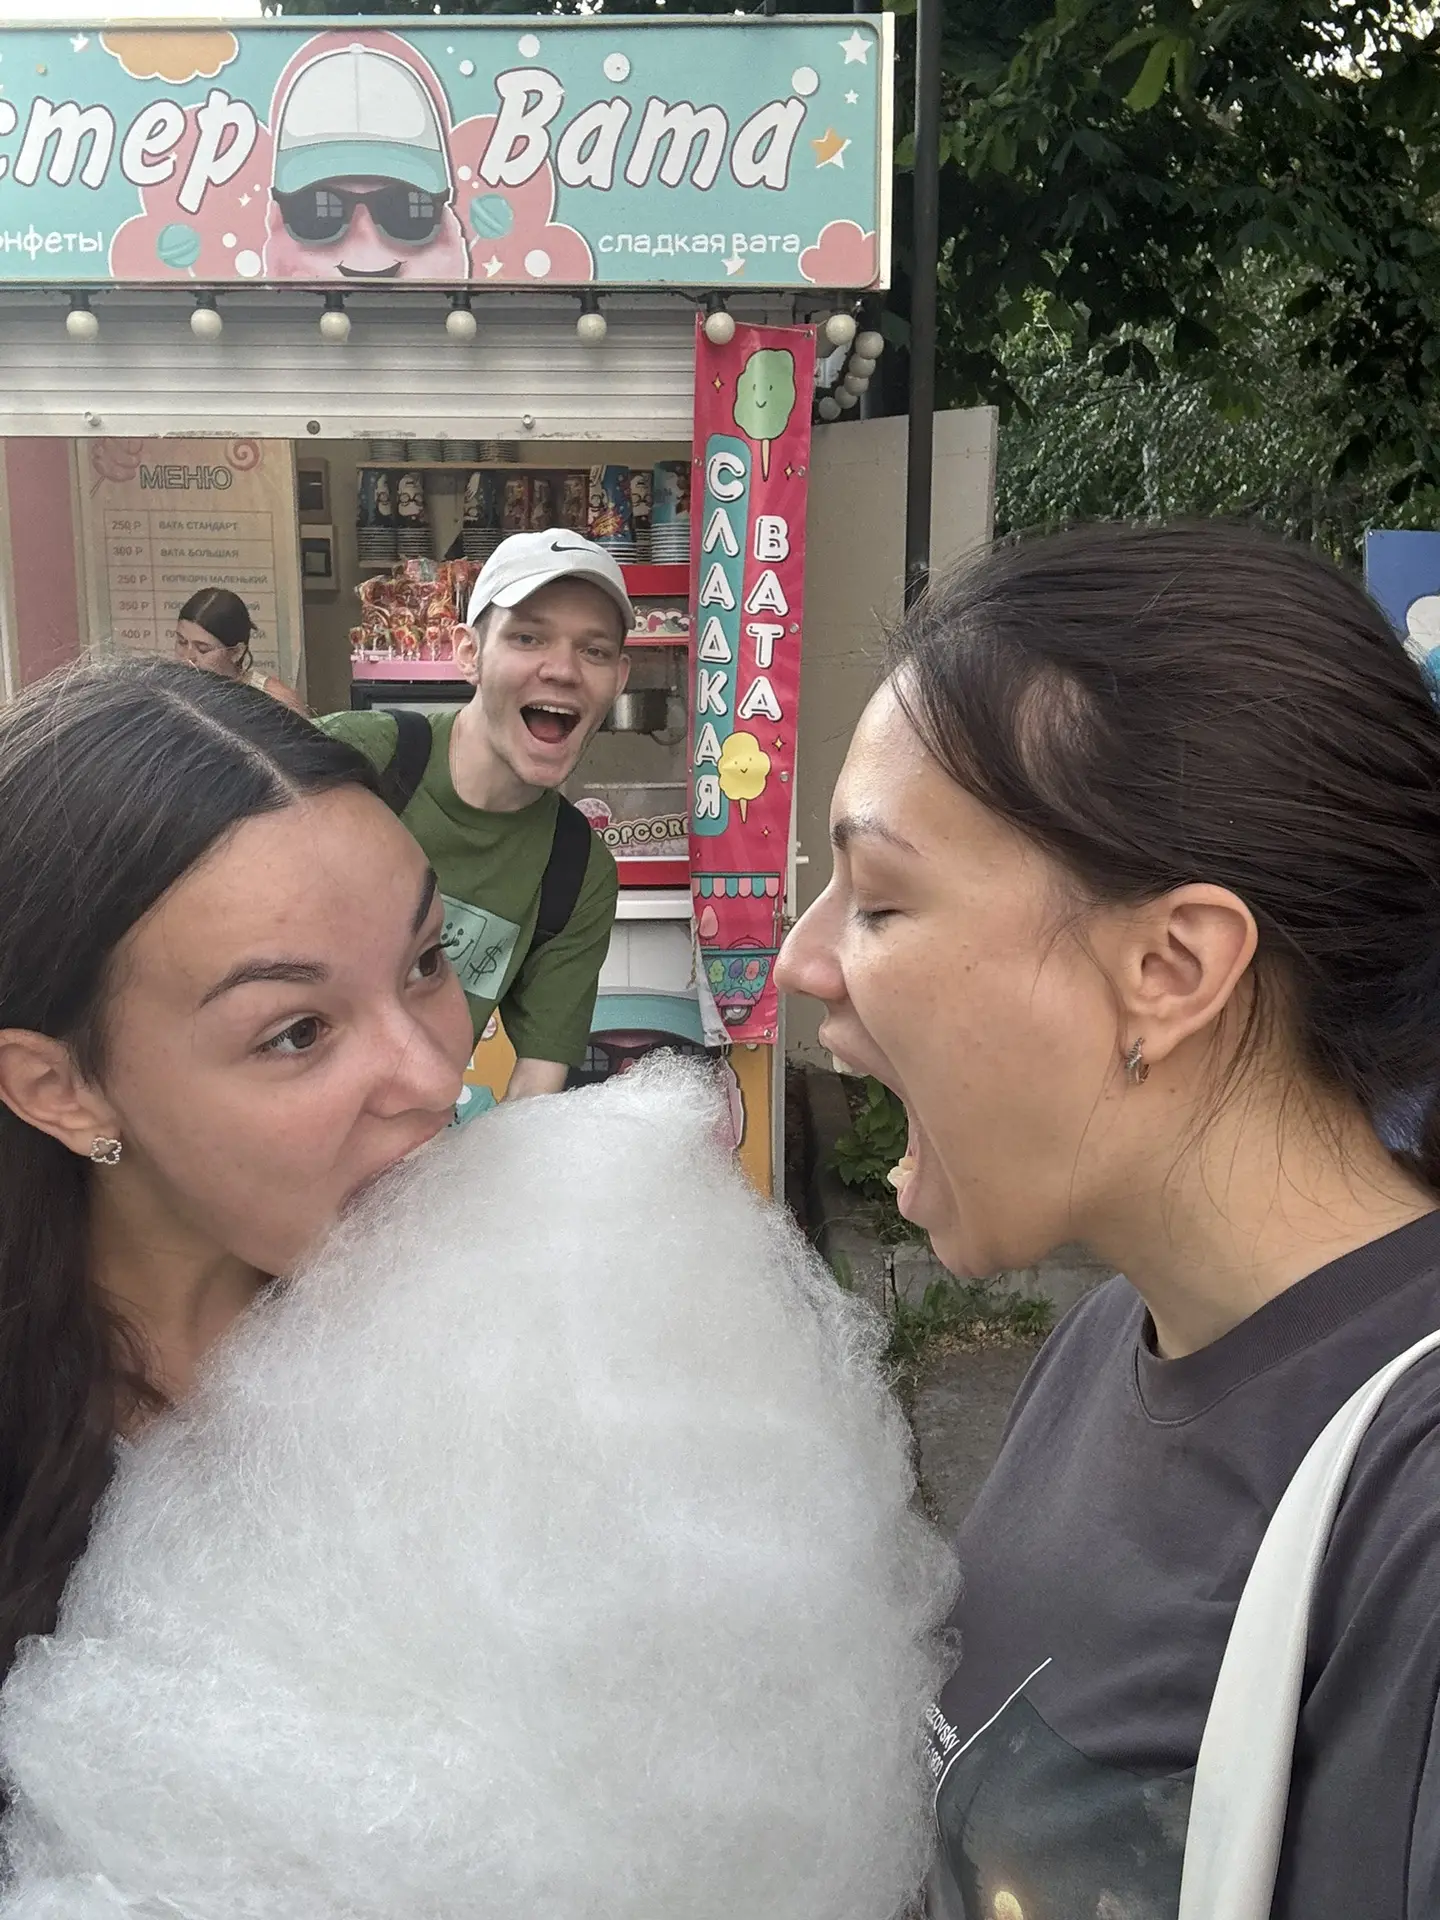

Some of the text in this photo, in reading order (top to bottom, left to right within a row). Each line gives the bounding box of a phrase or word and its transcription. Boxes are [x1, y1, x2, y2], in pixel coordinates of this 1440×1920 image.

[479, 66, 806, 191] Вата
[0, 223, 104, 261] нфеты
[599, 233, 800, 256] сладкая вата
[139, 464, 233, 491] МЕНЮ
[159, 521, 184, 531] ВАТА
[186, 521, 239, 532] СТАНДАРТ
[160, 548, 185, 558] ВАТА
[188, 548, 240, 559] БОЛЬШАЯ
[117, 574, 137, 585] 250
[737, 515, 790, 722] ВАТА
[694, 451, 747, 820] СЛАДКАЯ
[596, 817, 688, 848] OPCOR
